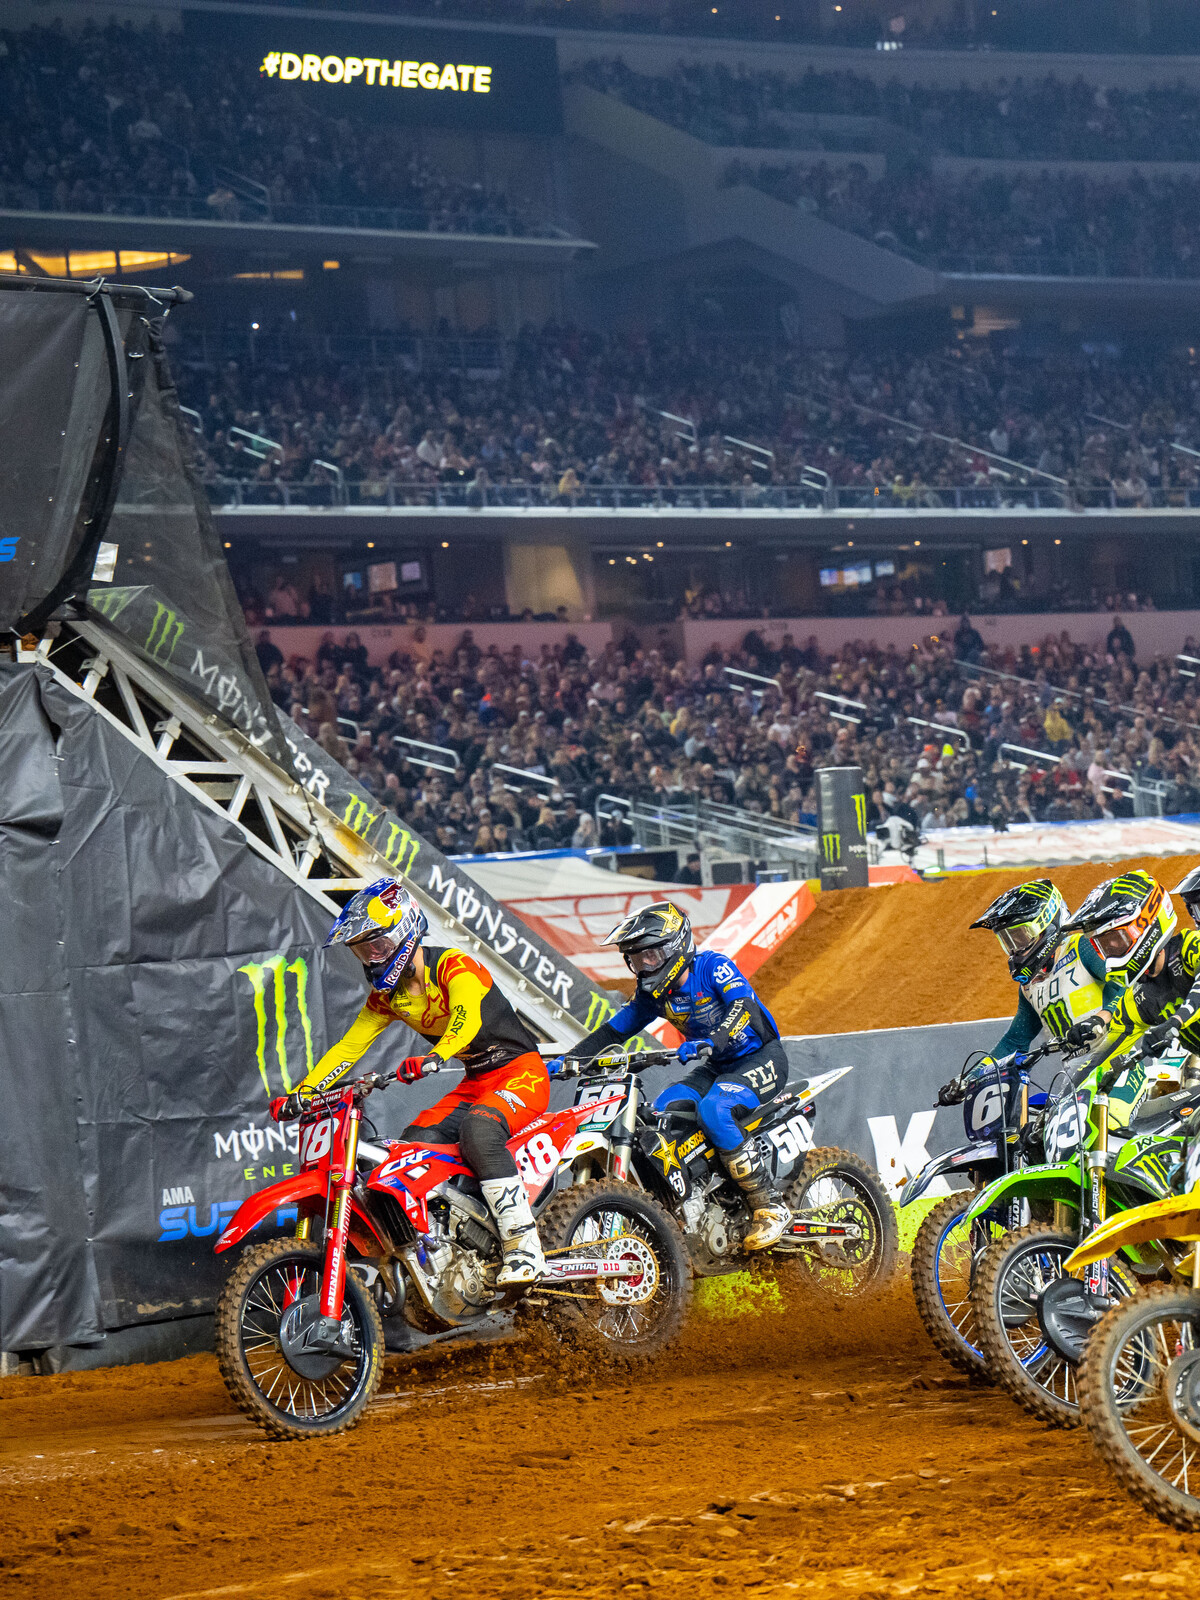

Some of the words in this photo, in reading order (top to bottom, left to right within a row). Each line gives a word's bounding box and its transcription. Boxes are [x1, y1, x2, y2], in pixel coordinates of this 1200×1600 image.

[261, 51, 493, 93] #DROPTHEGATE
[428, 864, 575, 1009] MONSTER
[751, 896, 799, 949] FLY
[1133, 927, 1160, 961] MONSTER
[316, 1060, 354, 1091] ONDA
[742, 1059, 778, 1088] FLY
[494, 1089, 516, 1114] HONDA
[972, 1082, 1011, 1131] 6
[1169, 1090, 1192, 1102] YAMAHA
[213, 1122, 300, 1162] MONS
[301, 1117, 340, 1165] 18
[677, 1130, 706, 1159] ROCKSTAR
[767, 1114, 813, 1164] 50
[1136, 1136, 1157, 1152] KX
[244, 1163, 294, 1181] ENE
[379, 1149, 431, 1178] CRF
[514, 1132, 561, 1186] 18
[1022, 1163, 1069, 1175] CIRCUIT
[162, 1186, 195, 1207] AMA
[328, 1247, 342, 1308] DUNLOP
[561, 1262, 598, 1272] ENTHAL
[603, 1262, 620, 1272] DID
